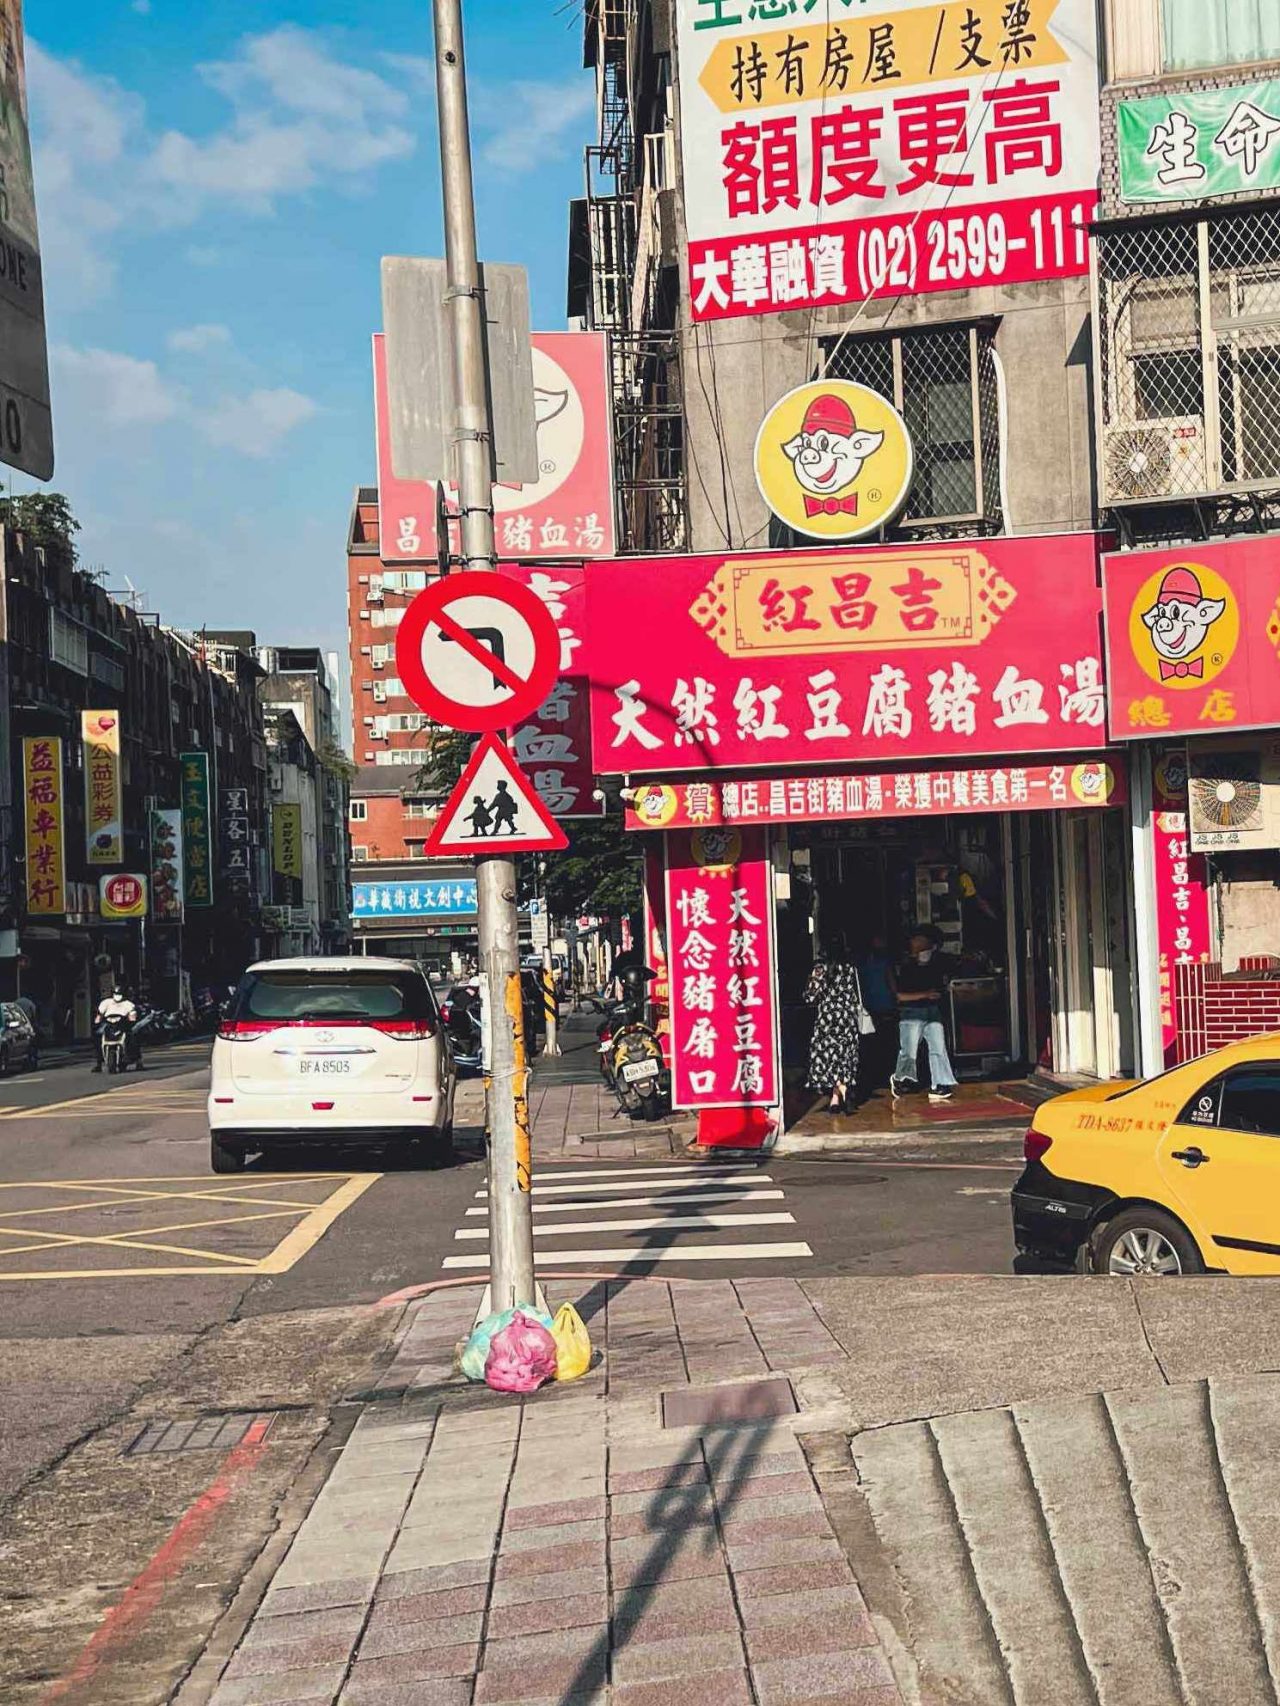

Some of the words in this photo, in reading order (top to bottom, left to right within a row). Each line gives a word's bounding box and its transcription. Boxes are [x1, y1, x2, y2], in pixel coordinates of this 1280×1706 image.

[729, 22, 901, 102] 持有房屋
[721, 78, 1062, 219] 額度更高
[692, 234, 848, 313] 大華融資
[858, 225, 918, 294] (02)
[928, 203, 1098, 283] 2599-111
[757, 568, 944, 634] 紅昌吉
[611, 657, 1106, 750] 天然紅豆腐豬血湯
[91, 743, 114, 822] 公益彩券
[726, 887, 764, 1096] 天然紅豆腐
